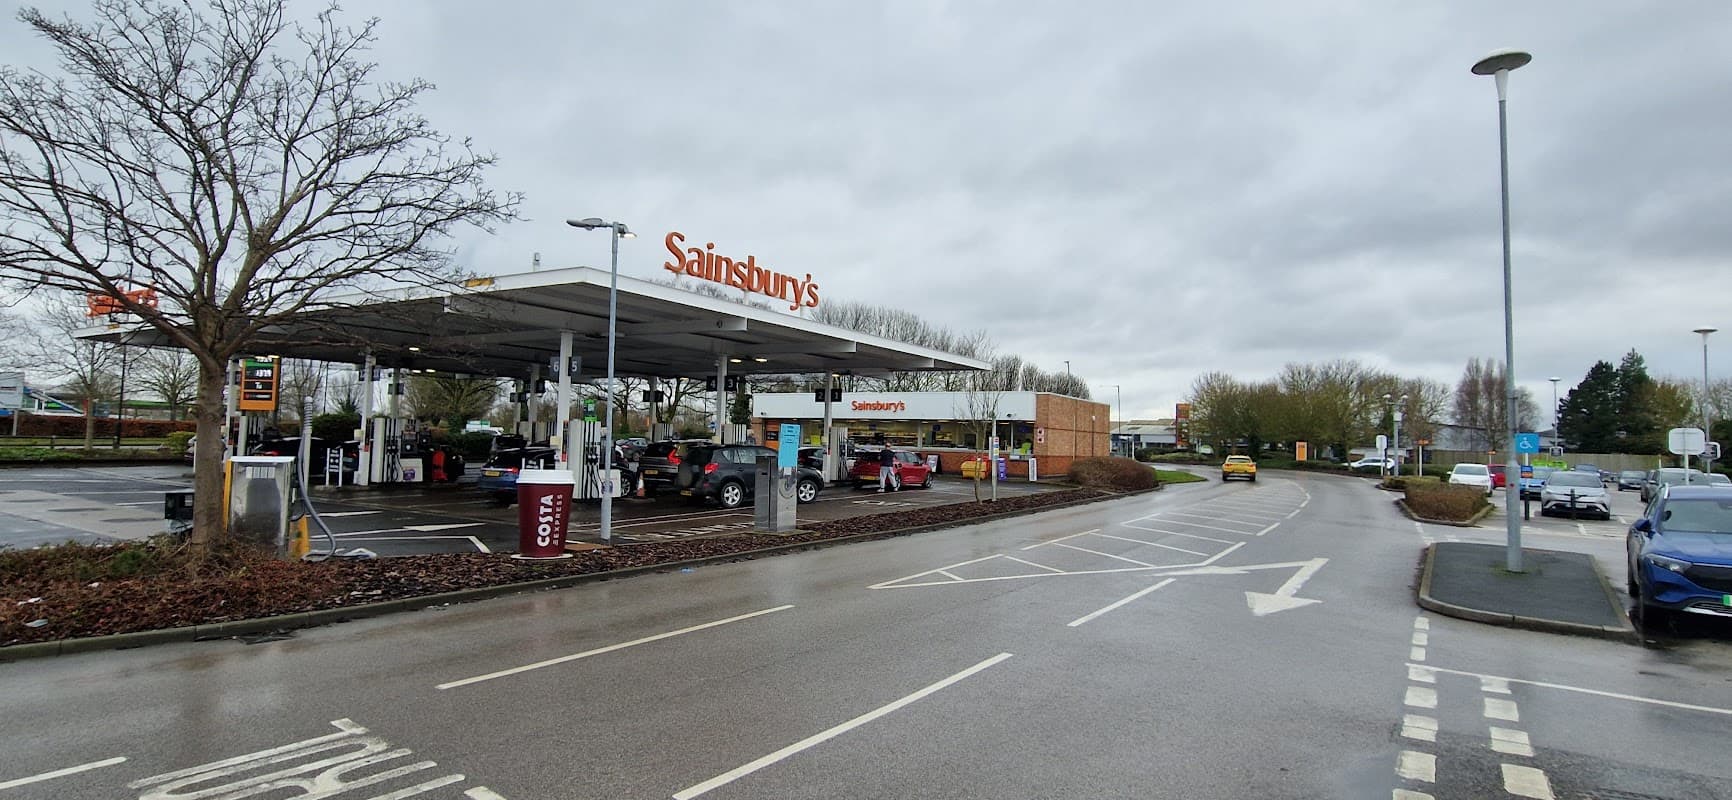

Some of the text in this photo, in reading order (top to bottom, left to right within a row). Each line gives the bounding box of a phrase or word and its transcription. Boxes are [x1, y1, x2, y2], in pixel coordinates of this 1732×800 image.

[664, 231, 819, 311] Sainsbury's
[571, 361, 578, 372] 5
[851, 400, 905, 413] Sainsbury's
[537, 494, 553, 547] COSTA
[553, 494, 563, 539] EXPRESS
